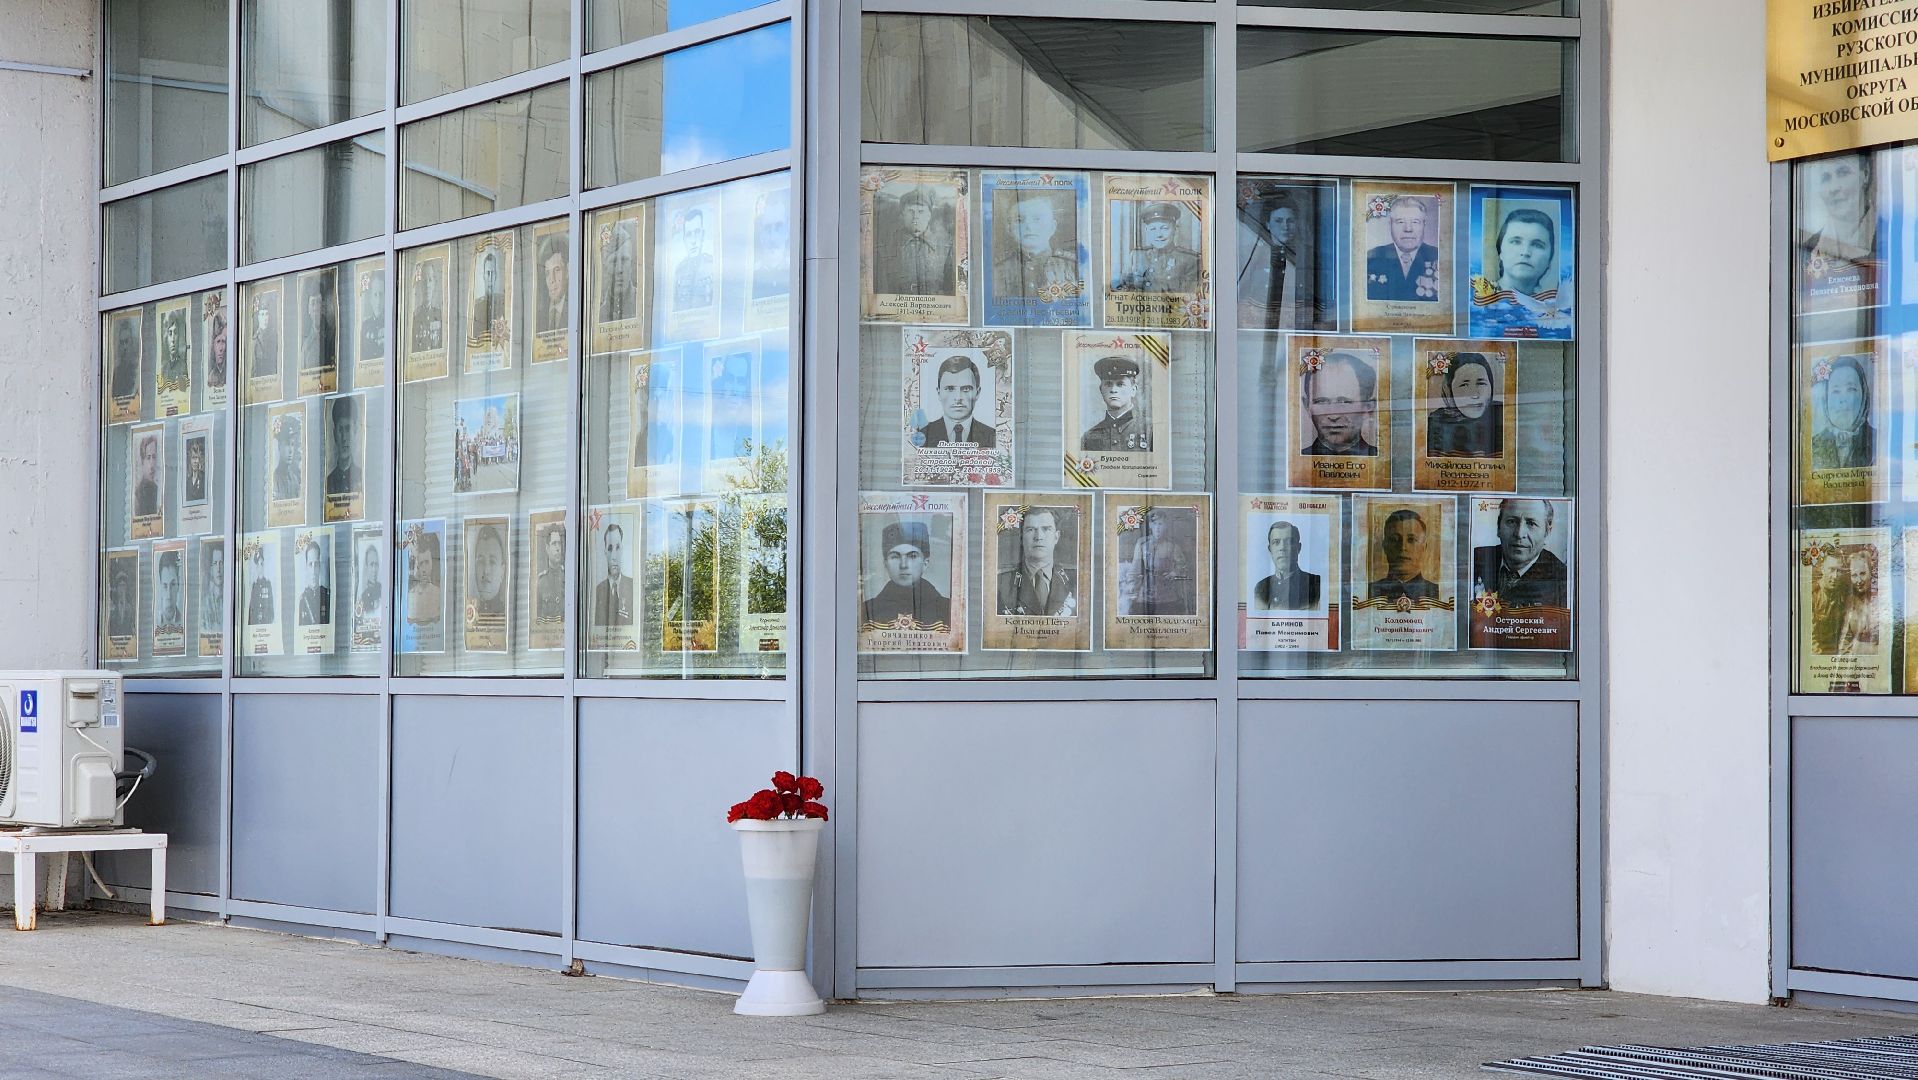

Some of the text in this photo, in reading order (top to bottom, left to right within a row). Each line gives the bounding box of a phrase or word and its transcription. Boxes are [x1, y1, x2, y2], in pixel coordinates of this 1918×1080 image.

[1837, 30, 1918, 58] РУЗСКОГО
[1847, 78, 1907, 100] ОКРУГА
[1785, 97, 1894, 132] МОСКОВСКОЙ
[1115, 301, 1173, 315] Труфакин
[1313, 461, 1367, 470] Иванов Егор
[1424, 460, 1506, 470] Михайлова Полина
[1320, 470, 1361, 479] Павлович
[1440, 471, 1490, 479] Васильевна
[1495, 616, 1545, 625] Островский
[1129, 626, 1188, 634] Михайлович
[1483, 625, 1558, 635] Андрей Сергеевич
